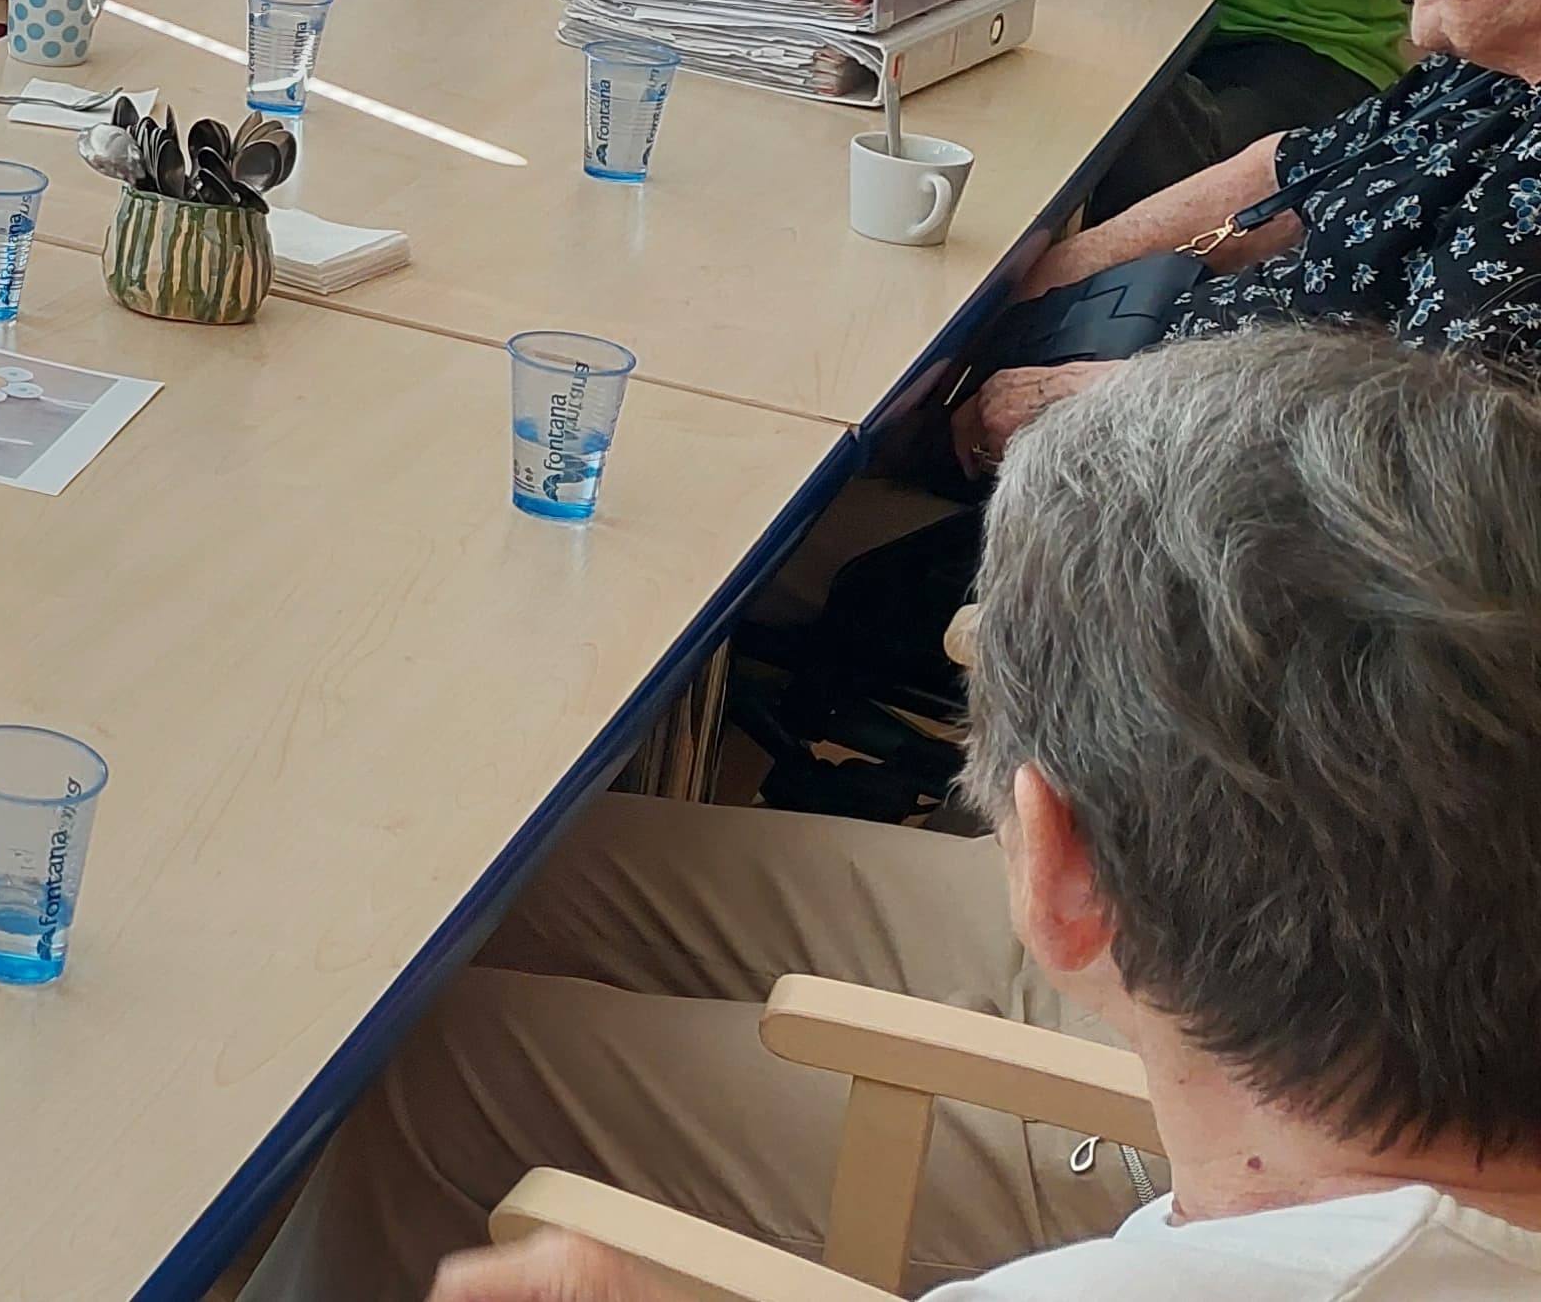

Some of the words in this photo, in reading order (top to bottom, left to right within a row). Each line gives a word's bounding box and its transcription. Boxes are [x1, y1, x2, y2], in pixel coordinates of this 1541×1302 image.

[597, 79, 611, 141] fontana
[544, 394, 568, 472] fontana
[39, 829, 68, 926] fontana
